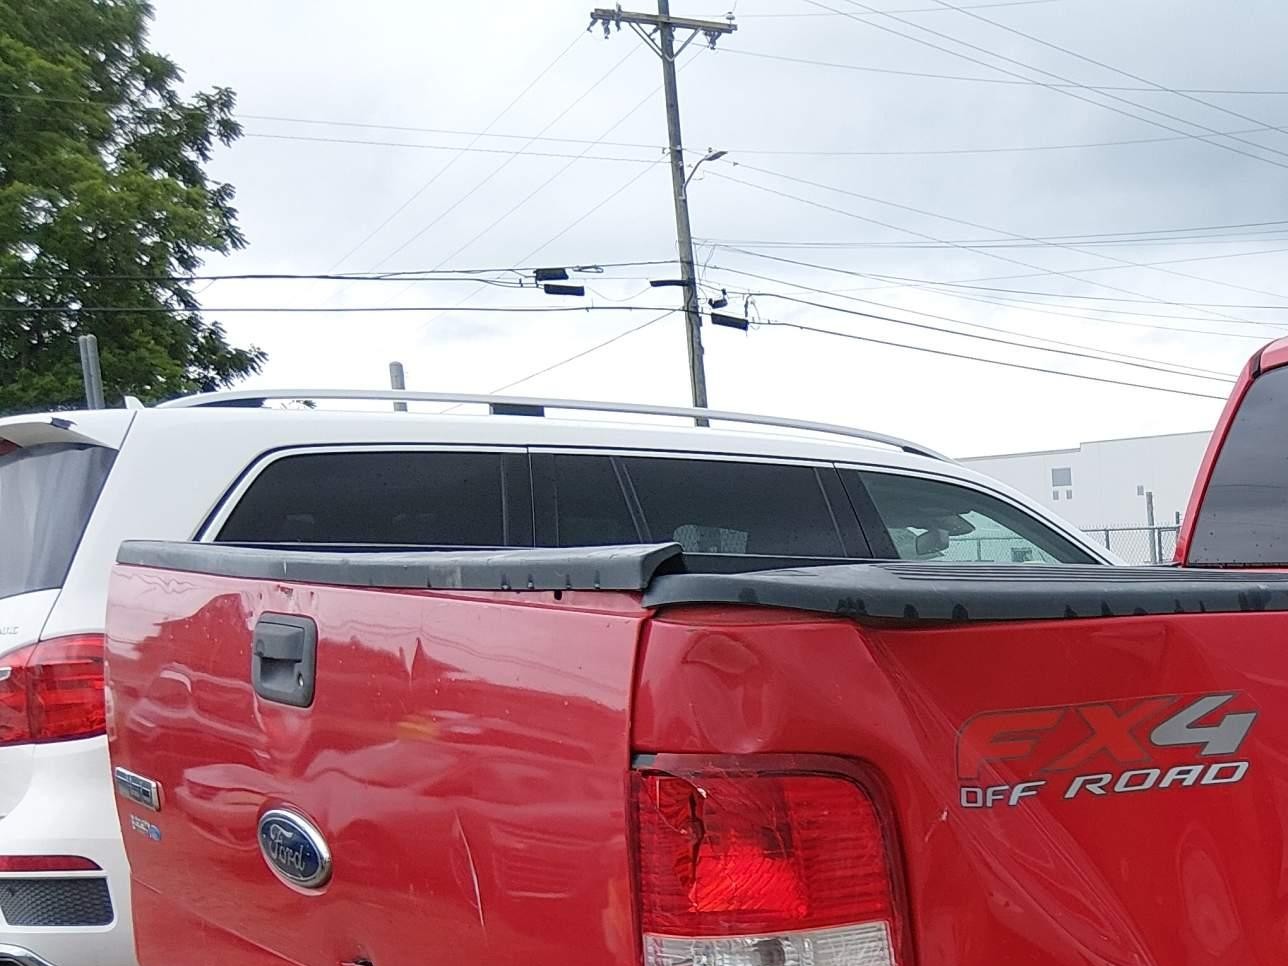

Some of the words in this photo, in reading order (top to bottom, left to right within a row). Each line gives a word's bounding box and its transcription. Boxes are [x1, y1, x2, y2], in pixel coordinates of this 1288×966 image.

[957, 692, 1258, 780] FX4
[960, 780, 1046, 809] OFF
[1064, 761, 1251, 800] ROAD
[269, 823, 305, 871] Ford
